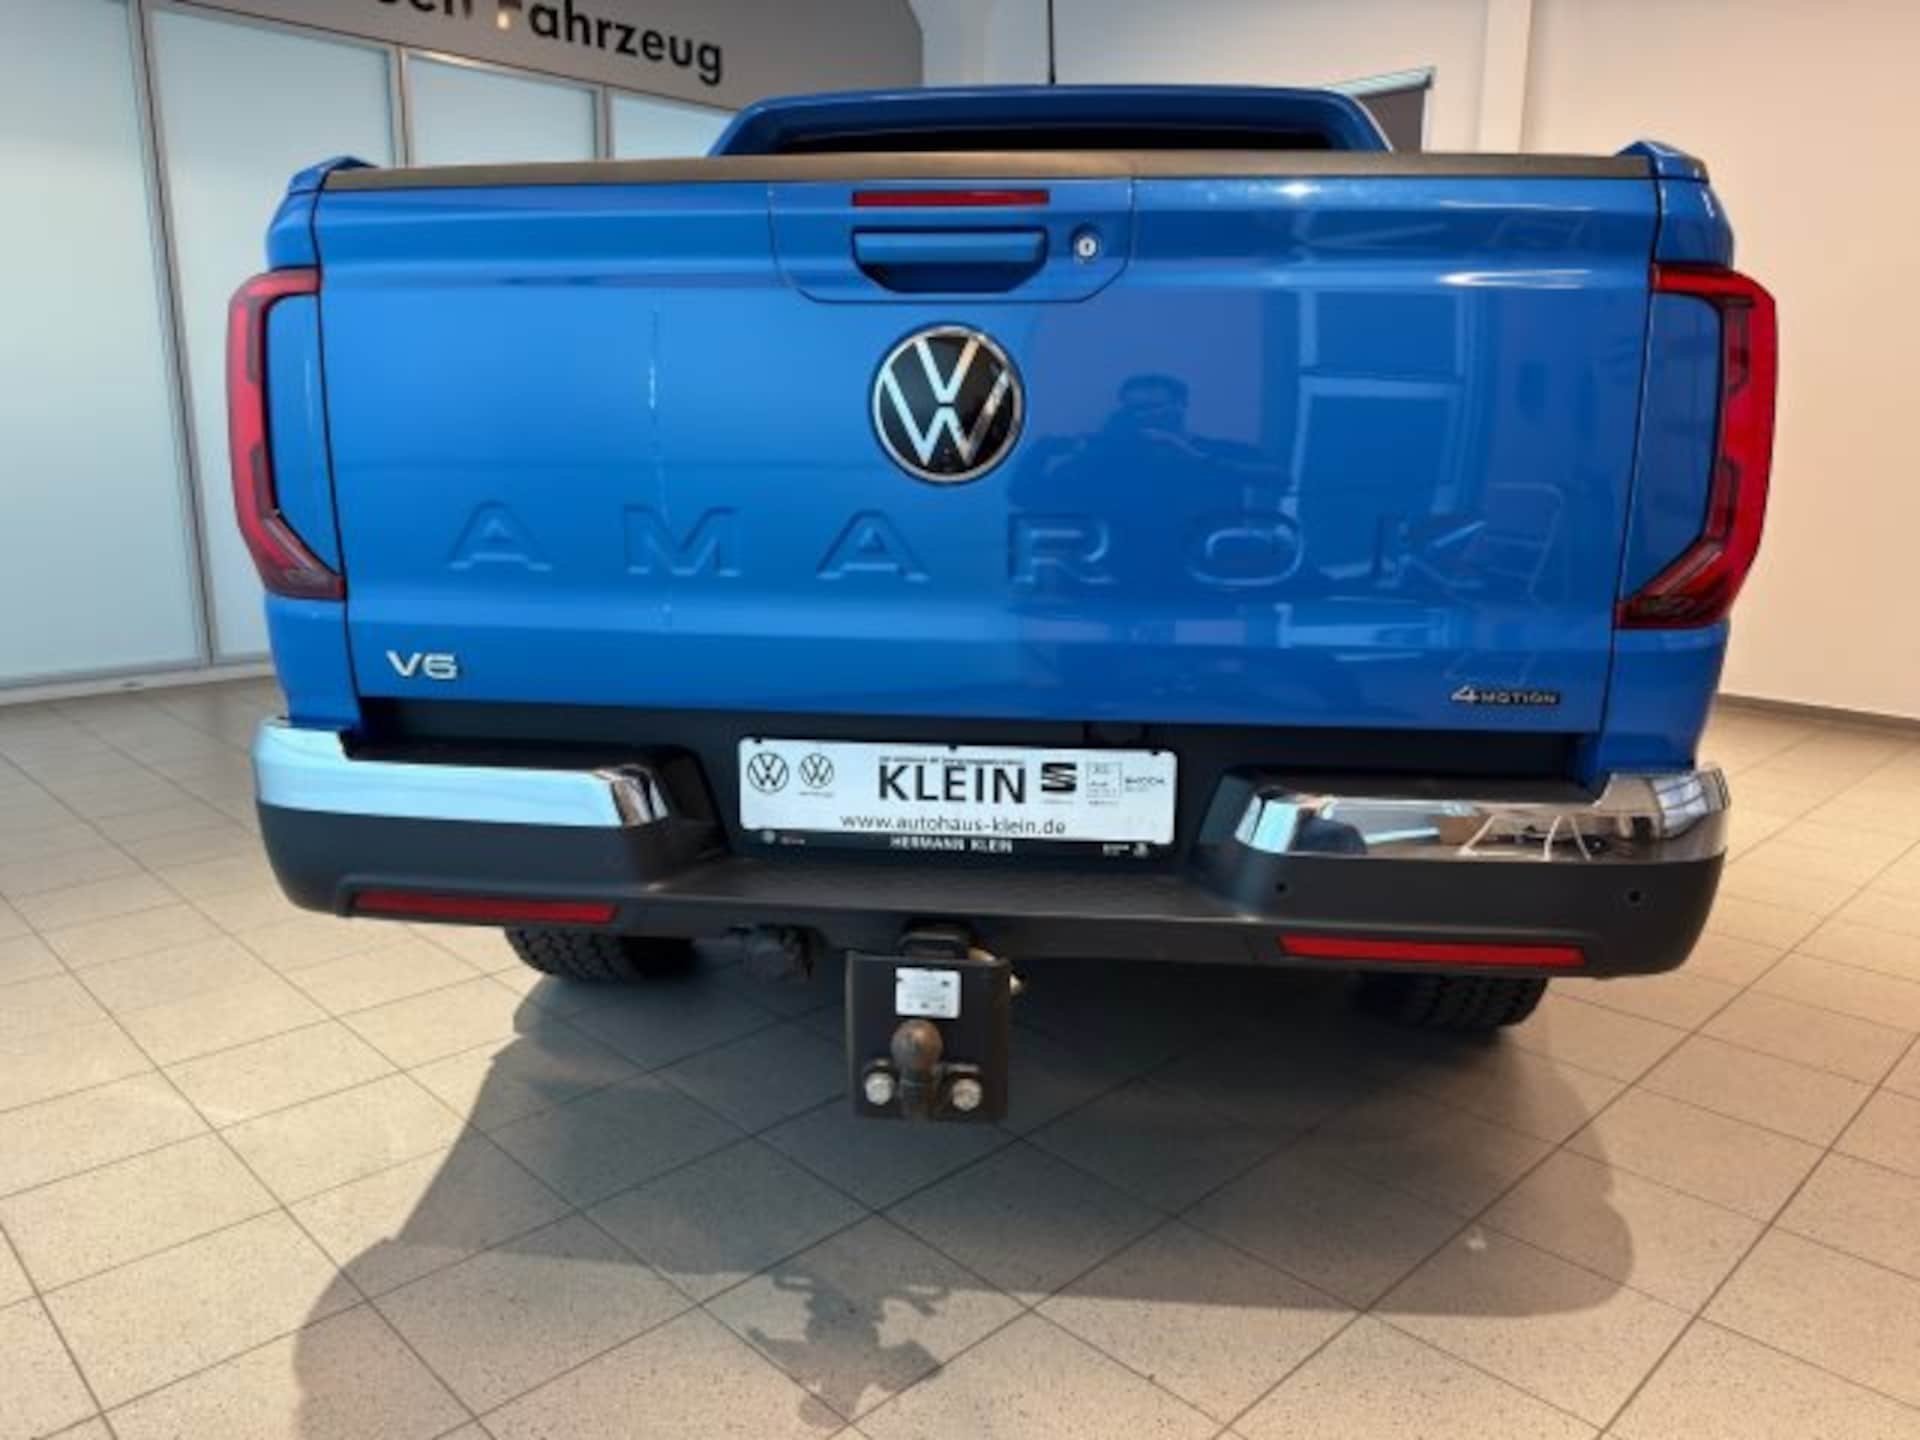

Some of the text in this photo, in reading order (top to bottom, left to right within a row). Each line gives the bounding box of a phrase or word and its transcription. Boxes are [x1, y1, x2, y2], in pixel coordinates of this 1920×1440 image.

[449, 499, 1488, 588] AMAROK
[386, 650, 458, 680] V6
[879, 764, 1026, 804] KLEIN
[840, 814, 1067, 835] www.autohaus-klein.de
